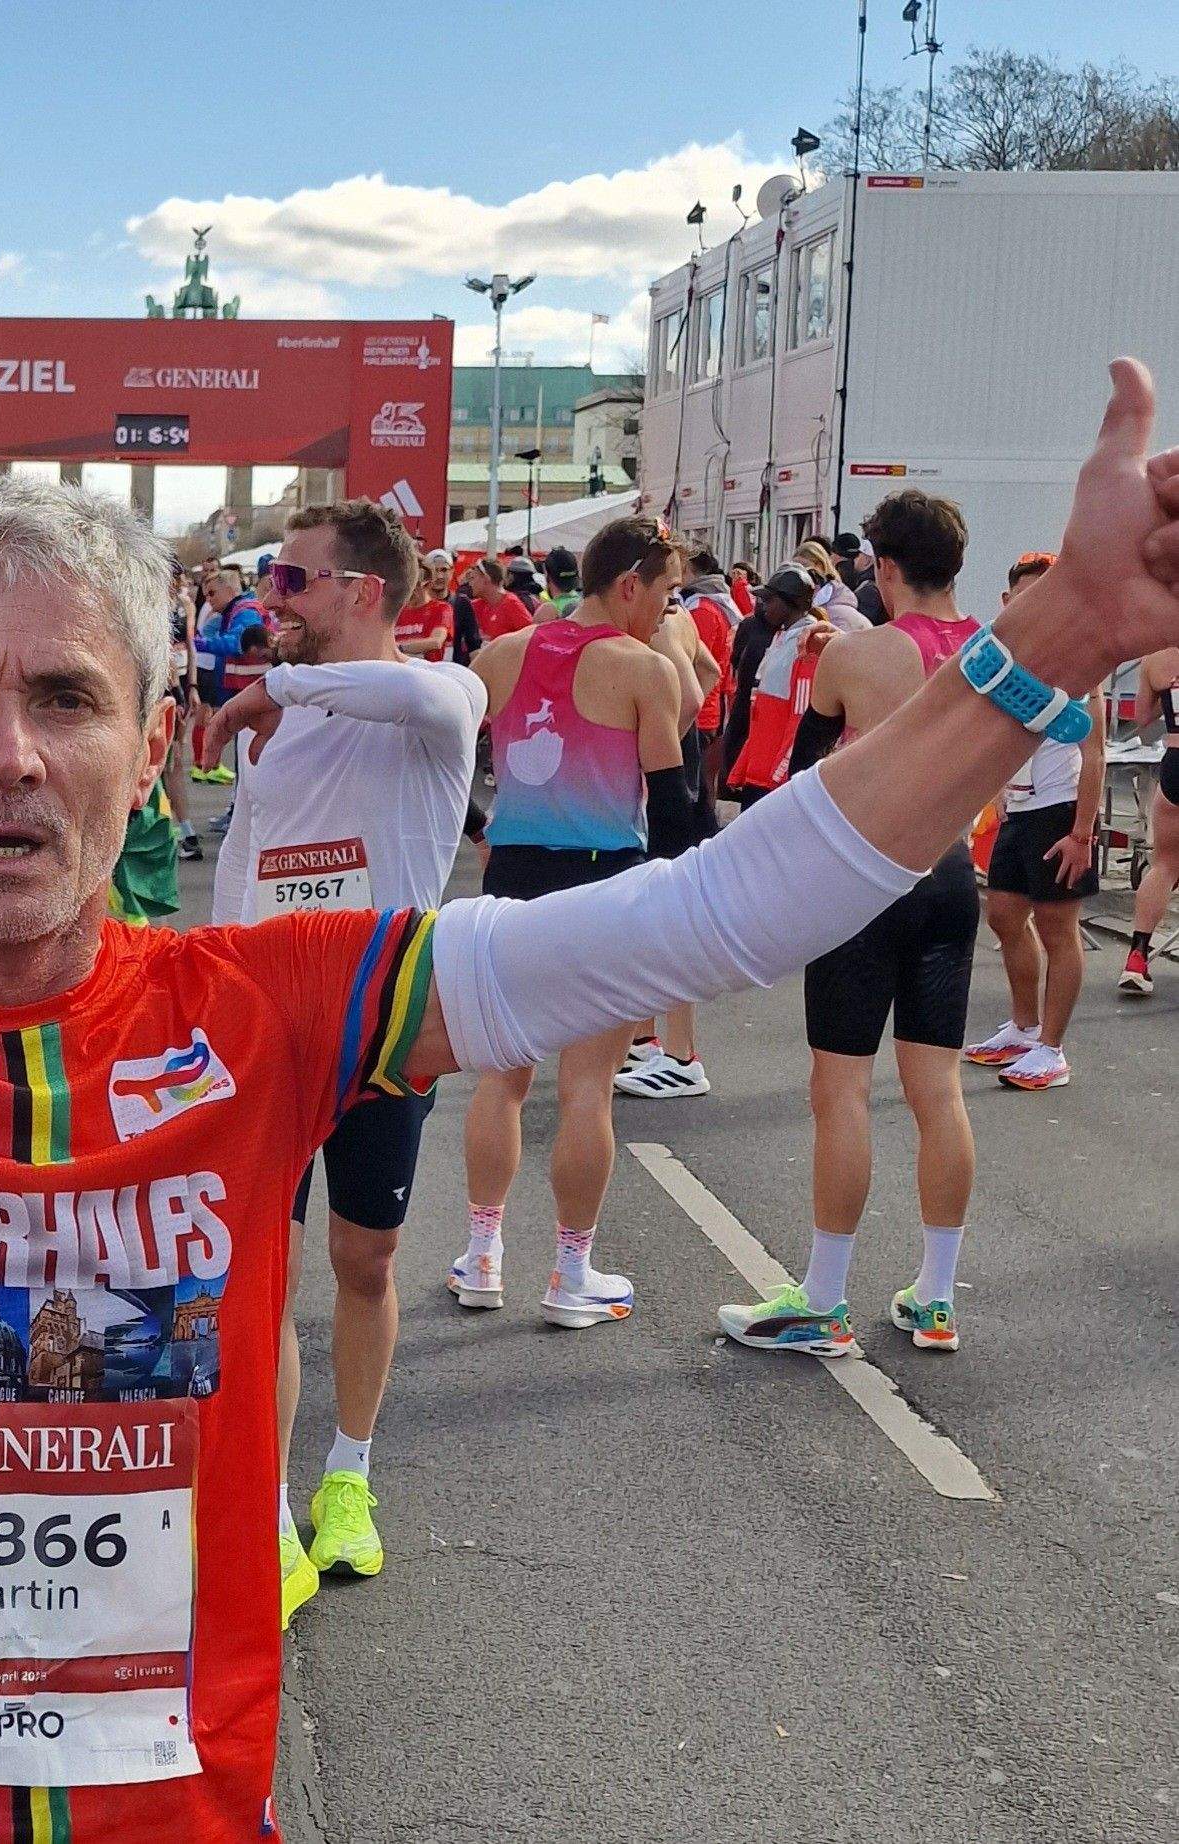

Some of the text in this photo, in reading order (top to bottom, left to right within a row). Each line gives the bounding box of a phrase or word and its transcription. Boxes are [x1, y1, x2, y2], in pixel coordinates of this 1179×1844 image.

[156, 367, 260, 389] GENERALI
[278, 846, 358, 870] GENERALI
[275, 878, 345, 903] 57967
[48, 1388, 86, 1404] CARDIFF
[119, 1387, 157, 1403] VALENCIA
[161, 1509, 171, 1531] A
[139, 1665, 175, 1677] EVENTS
